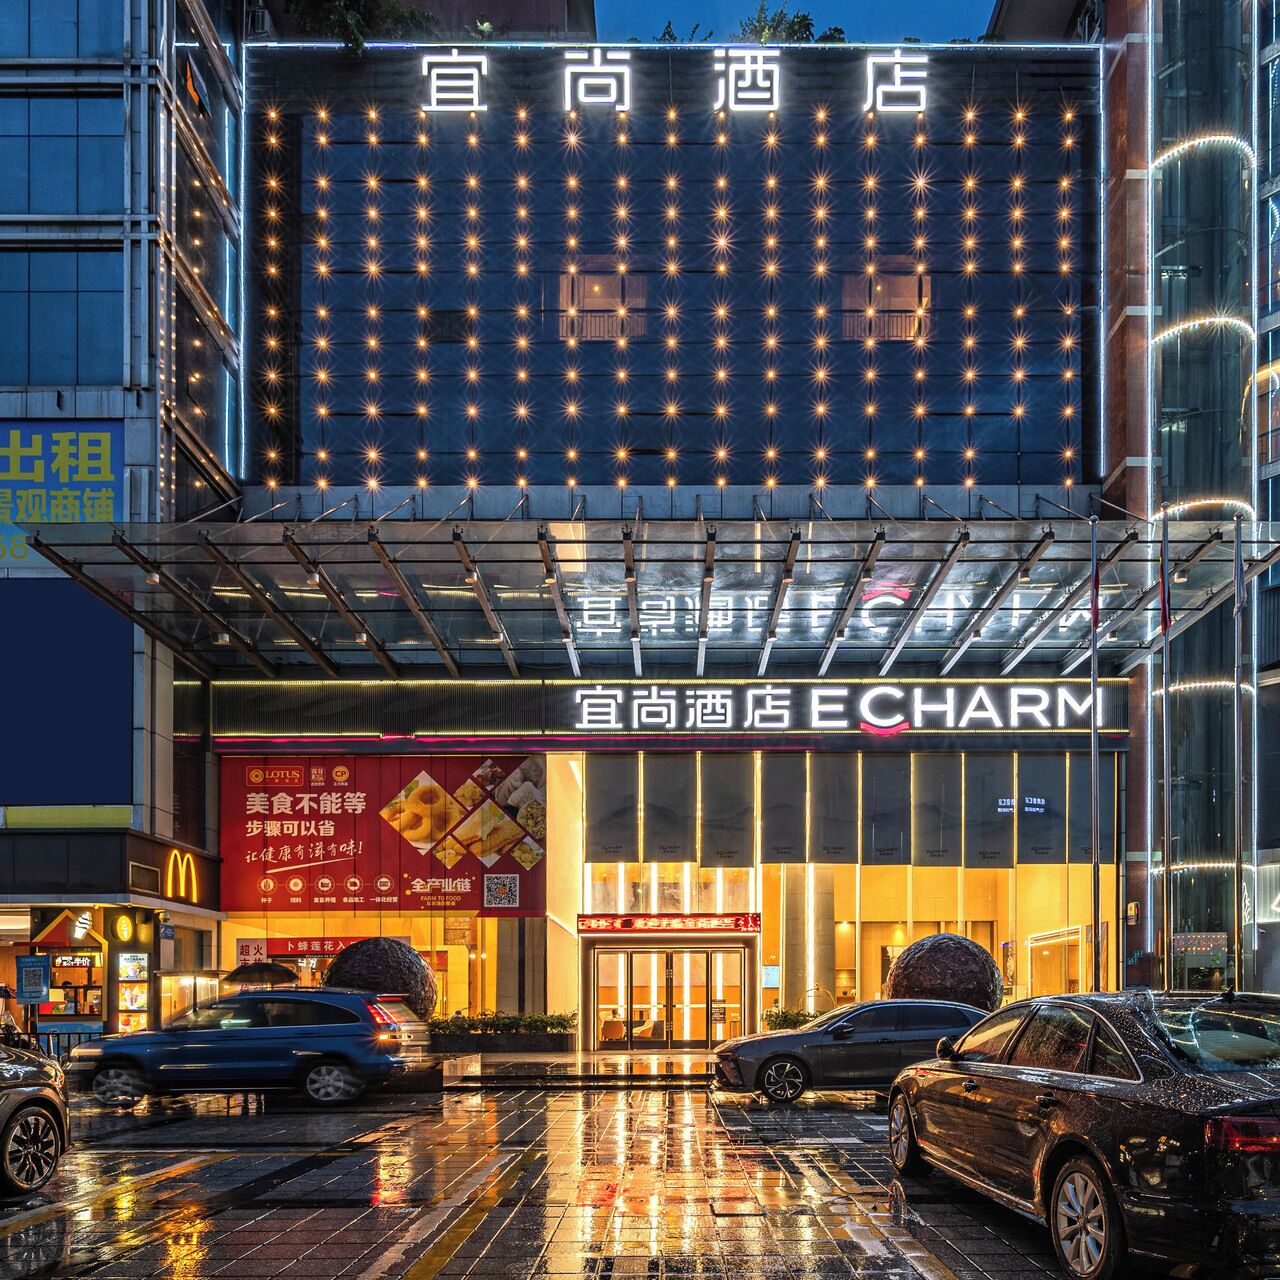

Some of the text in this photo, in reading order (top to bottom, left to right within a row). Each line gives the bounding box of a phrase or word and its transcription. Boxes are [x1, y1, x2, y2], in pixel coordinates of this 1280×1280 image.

[422, 49, 928, 112] 宜尚酒店
[575, 685, 791, 729] 宜尚酒店
[811, 685, 1103, 733] ECHARM
[265, 770, 300, 779] LOTUS
[246, 792, 367, 815] 美食不能等
[246, 820, 336, 838] 步骤可以省
[411, 878, 472, 892] 全产业链
